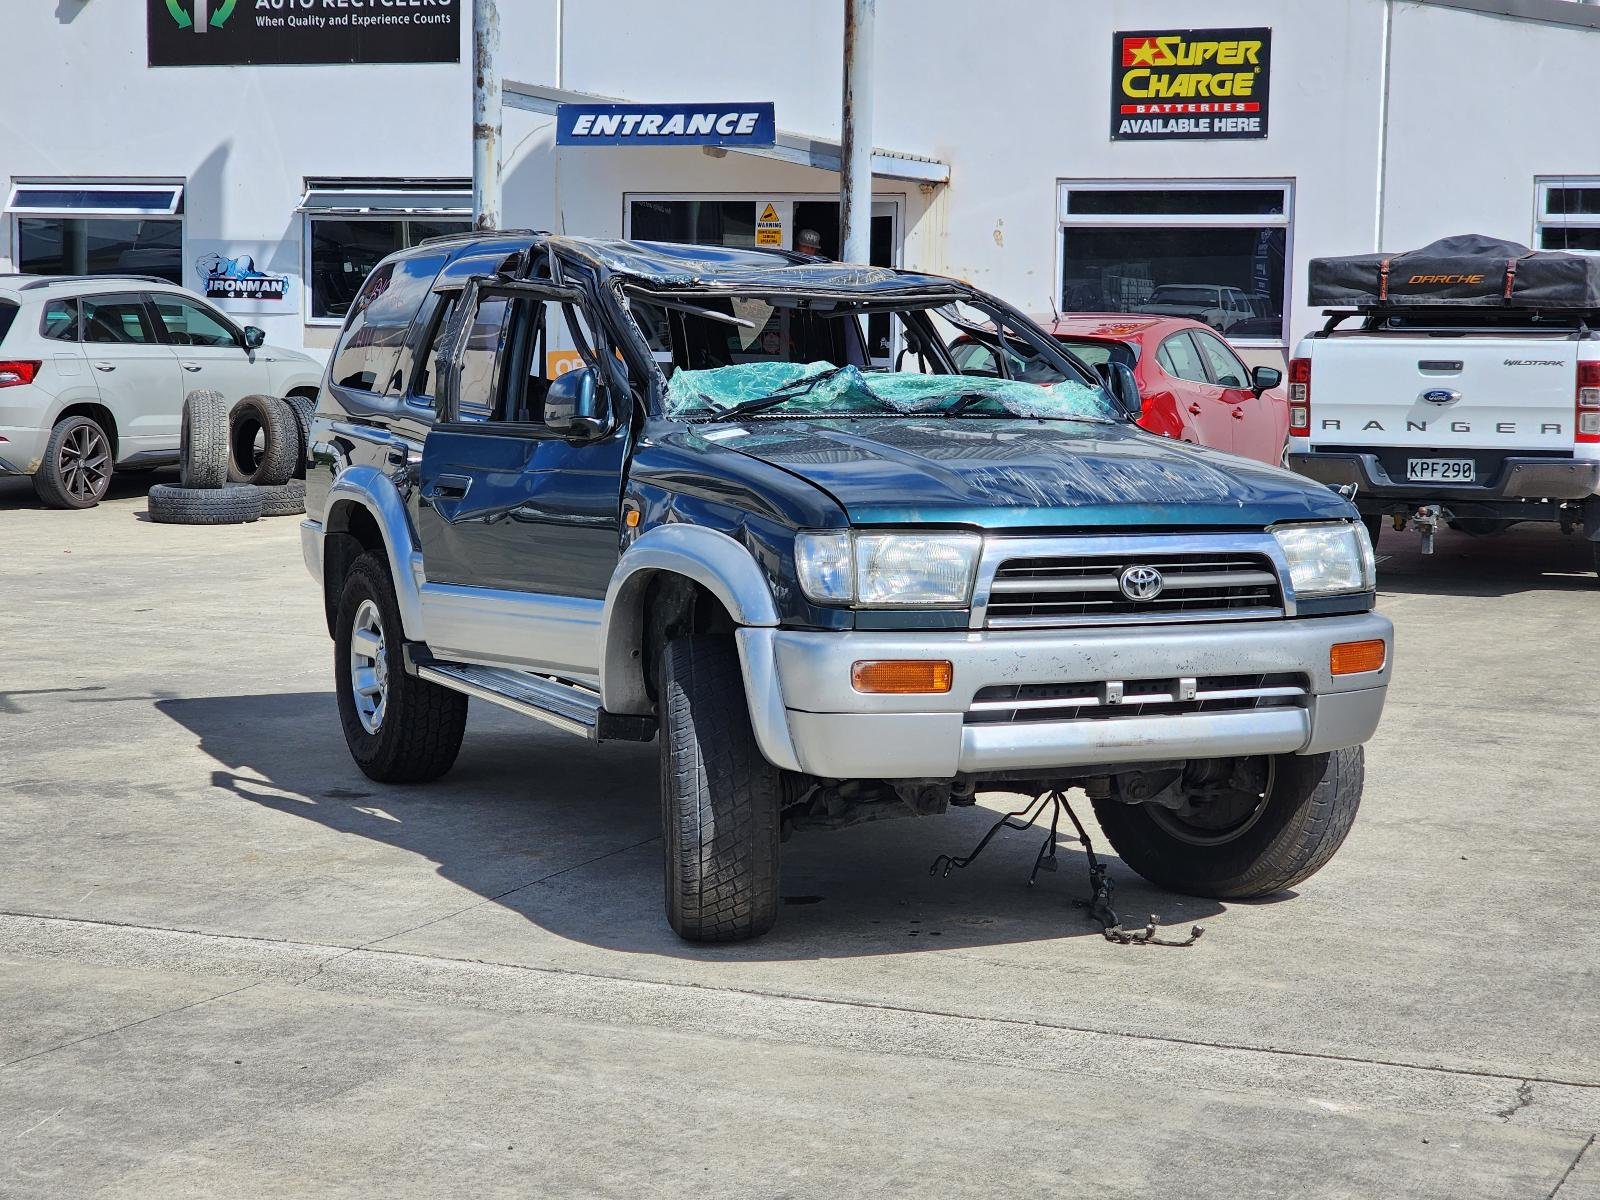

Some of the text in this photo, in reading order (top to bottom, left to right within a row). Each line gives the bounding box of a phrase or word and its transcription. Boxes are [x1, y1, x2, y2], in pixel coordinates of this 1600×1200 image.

[255, 13, 451, 28] When Quality and Experience Counts
[1152, 36, 1262, 66] SUPER
[1121, 68, 1254, 98] CHARGE
[1136, 103, 1246, 113] BATTERIES
[571, 112, 760, 136] ENTRANCE
[1119, 117, 1261, 134] AVAILABLE HERE
[208, 280, 283, 292] IRONMAN
[1408, 274, 1484, 284] DARCHE
[1503, 359, 1565, 367] WILDTRAK
[1321, 419, 1562, 434] RANGER
[1410, 462, 1472, 479] KPF290
